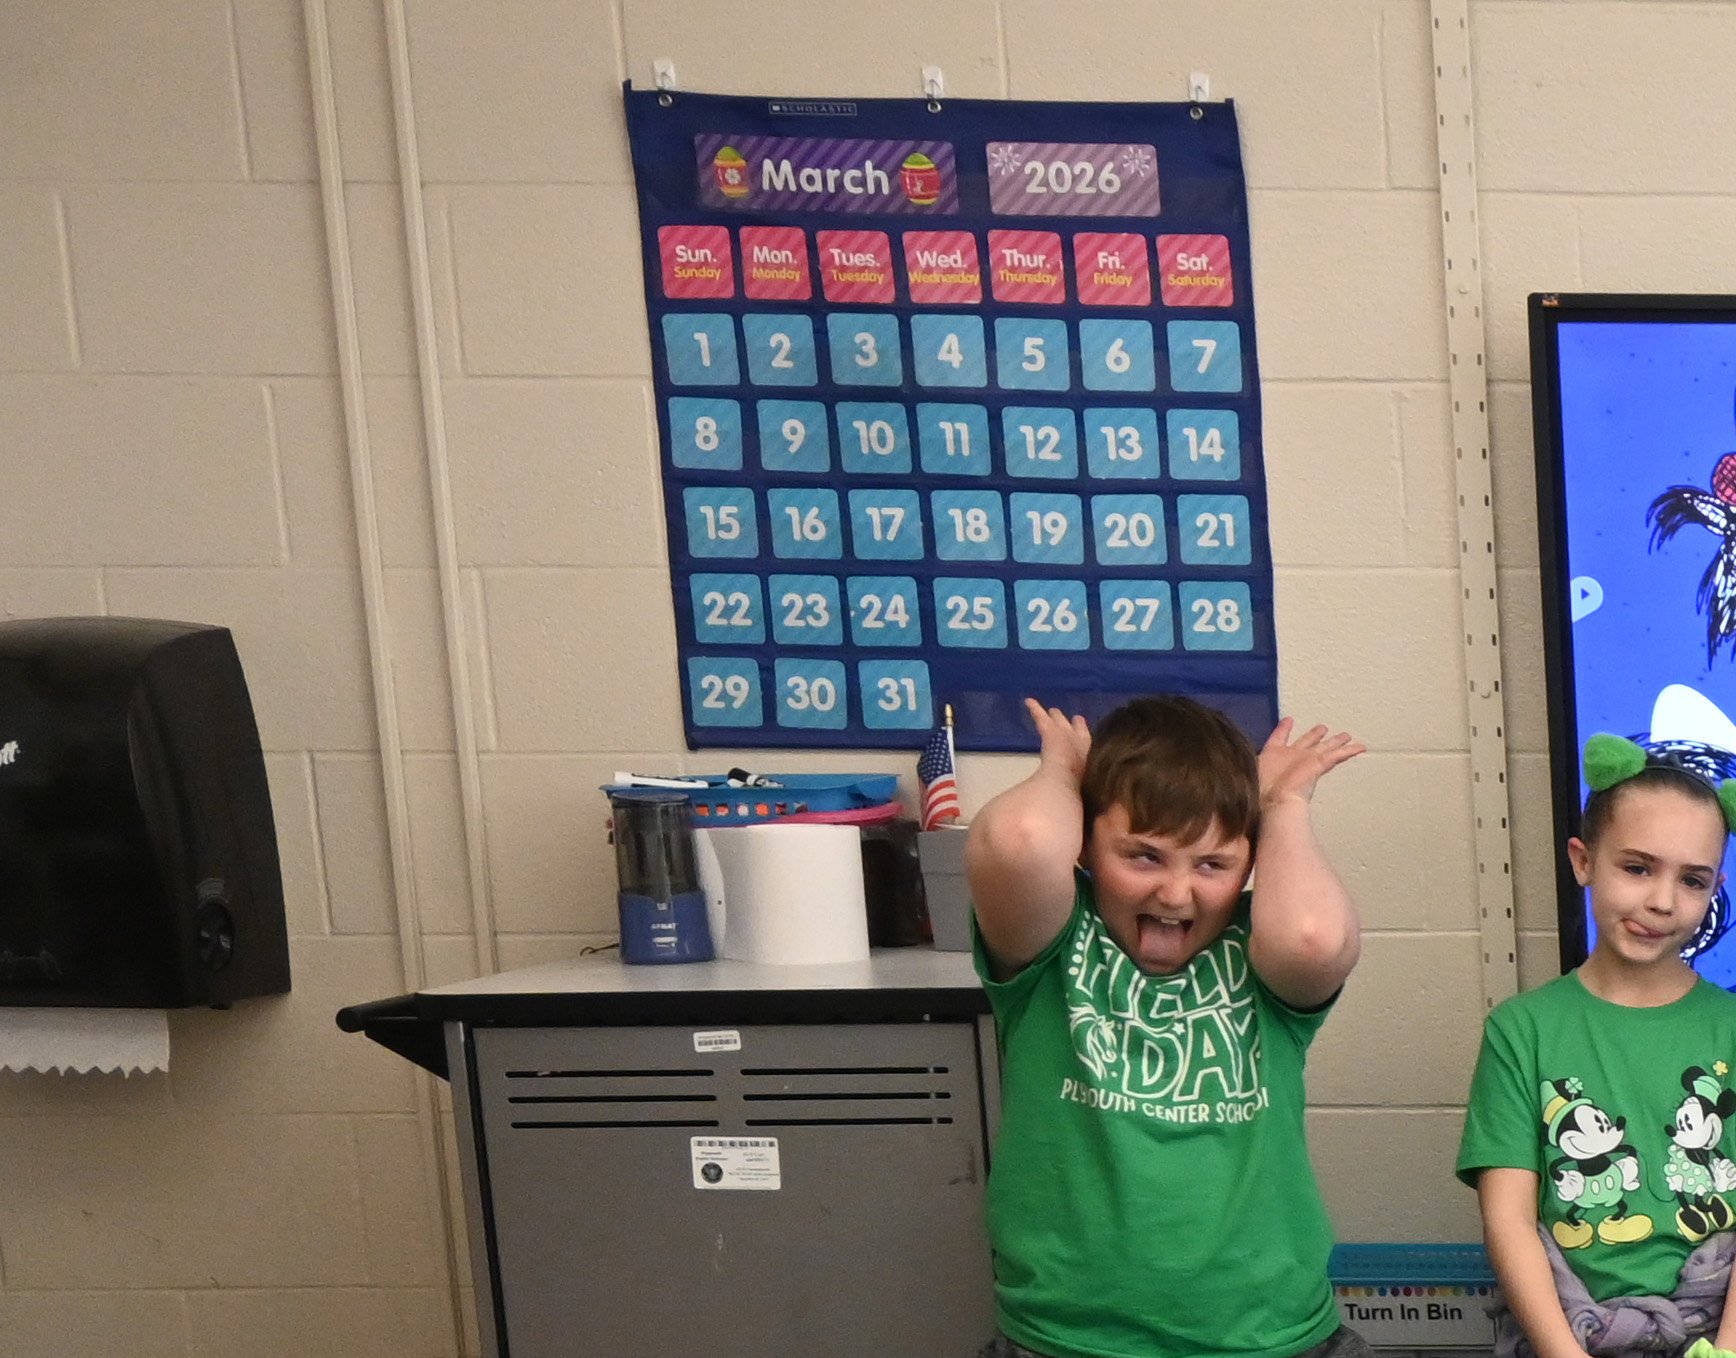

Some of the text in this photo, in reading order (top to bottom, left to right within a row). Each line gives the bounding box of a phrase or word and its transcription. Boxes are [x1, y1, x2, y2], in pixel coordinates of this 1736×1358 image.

[762, 158, 890, 195] March
[1024, 161, 1121, 194] 2026
[676, 245, 717, 263] Sun.
[753, 246, 798, 264] Mon.
[830, 248, 881, 267] Tues.
[916, 250, 967, 268] Wed.
[1002, 249, 1050, 268] Thur.
[1098, 252, 1125, 270] Fri.
[1176, 253, 1213, 271] Sat.
[674, 267, 722, 281] Sunday
[753, 268, 801, 283] Monday
[831, 269, 885, 285] Tuesday
[909, 271, 980, 286] Wednesday
[999, 270, 1057, 286] Thursday
[1094, 272, 1132, 287] Friday
[1168, 273, 1226, 288] Saturday
[694, 333, 710, 366] 1
[770, 333, 793, 368] 2
[855, 332, 878, 366] 3
[938, 334, 963, 368] 4
[1023, 338, 1045, 371] 5
[1106, 339, 1130, 373] 6
[1192, 340, 1216, 373] 7
[696, 417, 718, 451] 8
[782, 419, 805, 453] 9
[853, 421, 895, 455] 10
[939, 422, 969, 456] 11
[1020, 426, 1061, 461] 12
[1101, 427, 1143, 460] 13
[1183, 428, 1225, 462] 14
[700, 506, 740, 539] 15
[785, 507, 826, 541] 16
[866, 507, 904, 540] 17
[948, 508, 991, 542] 18
[1027, 511, 1067, 545] 19
[1105, 513, 1154, 547] 20
[1196, 513, 1234, 547] 21
[704, 592, 752, 625] 22
[782, 593, 829, 627] 23
[860, 594, 909, 628] 24
[946, 596, 994, 630] 25
[1028, 598, 1077, 632] 26
[1113, 598, 1159, 632] 27
[1192, 599, 1240, 632] 28
[702, 675, 749, 708] 29
[787, 676, 835, 711] 30
[878, 678, 916, 710] 31
[1122, 1009, 1259, 1101] DAY
[1142, 1103, 1210, 1123] CENTER
[1345, 1304, 1463, 1321] Turn In Bin
